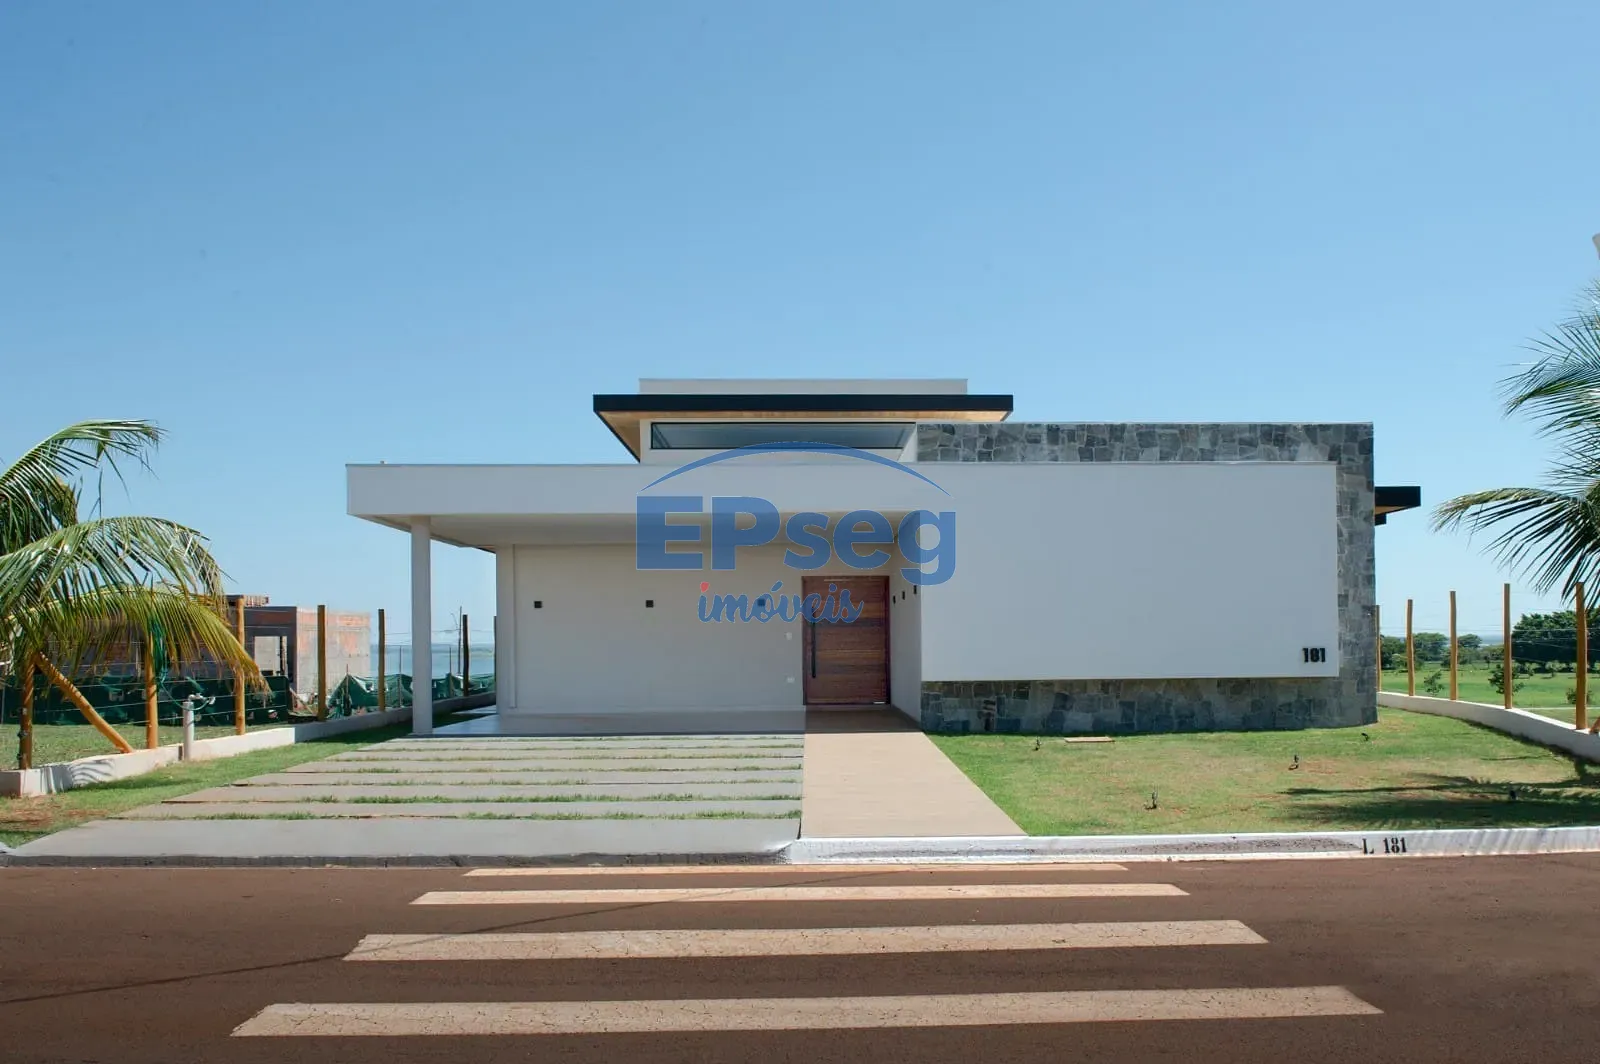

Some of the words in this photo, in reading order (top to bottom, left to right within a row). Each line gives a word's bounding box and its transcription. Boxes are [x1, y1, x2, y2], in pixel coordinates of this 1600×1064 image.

[1302, 647, 1326, 663] 181
[1362, 838, 1375, 854] L
[1383, 837, 1407, 854] 181
